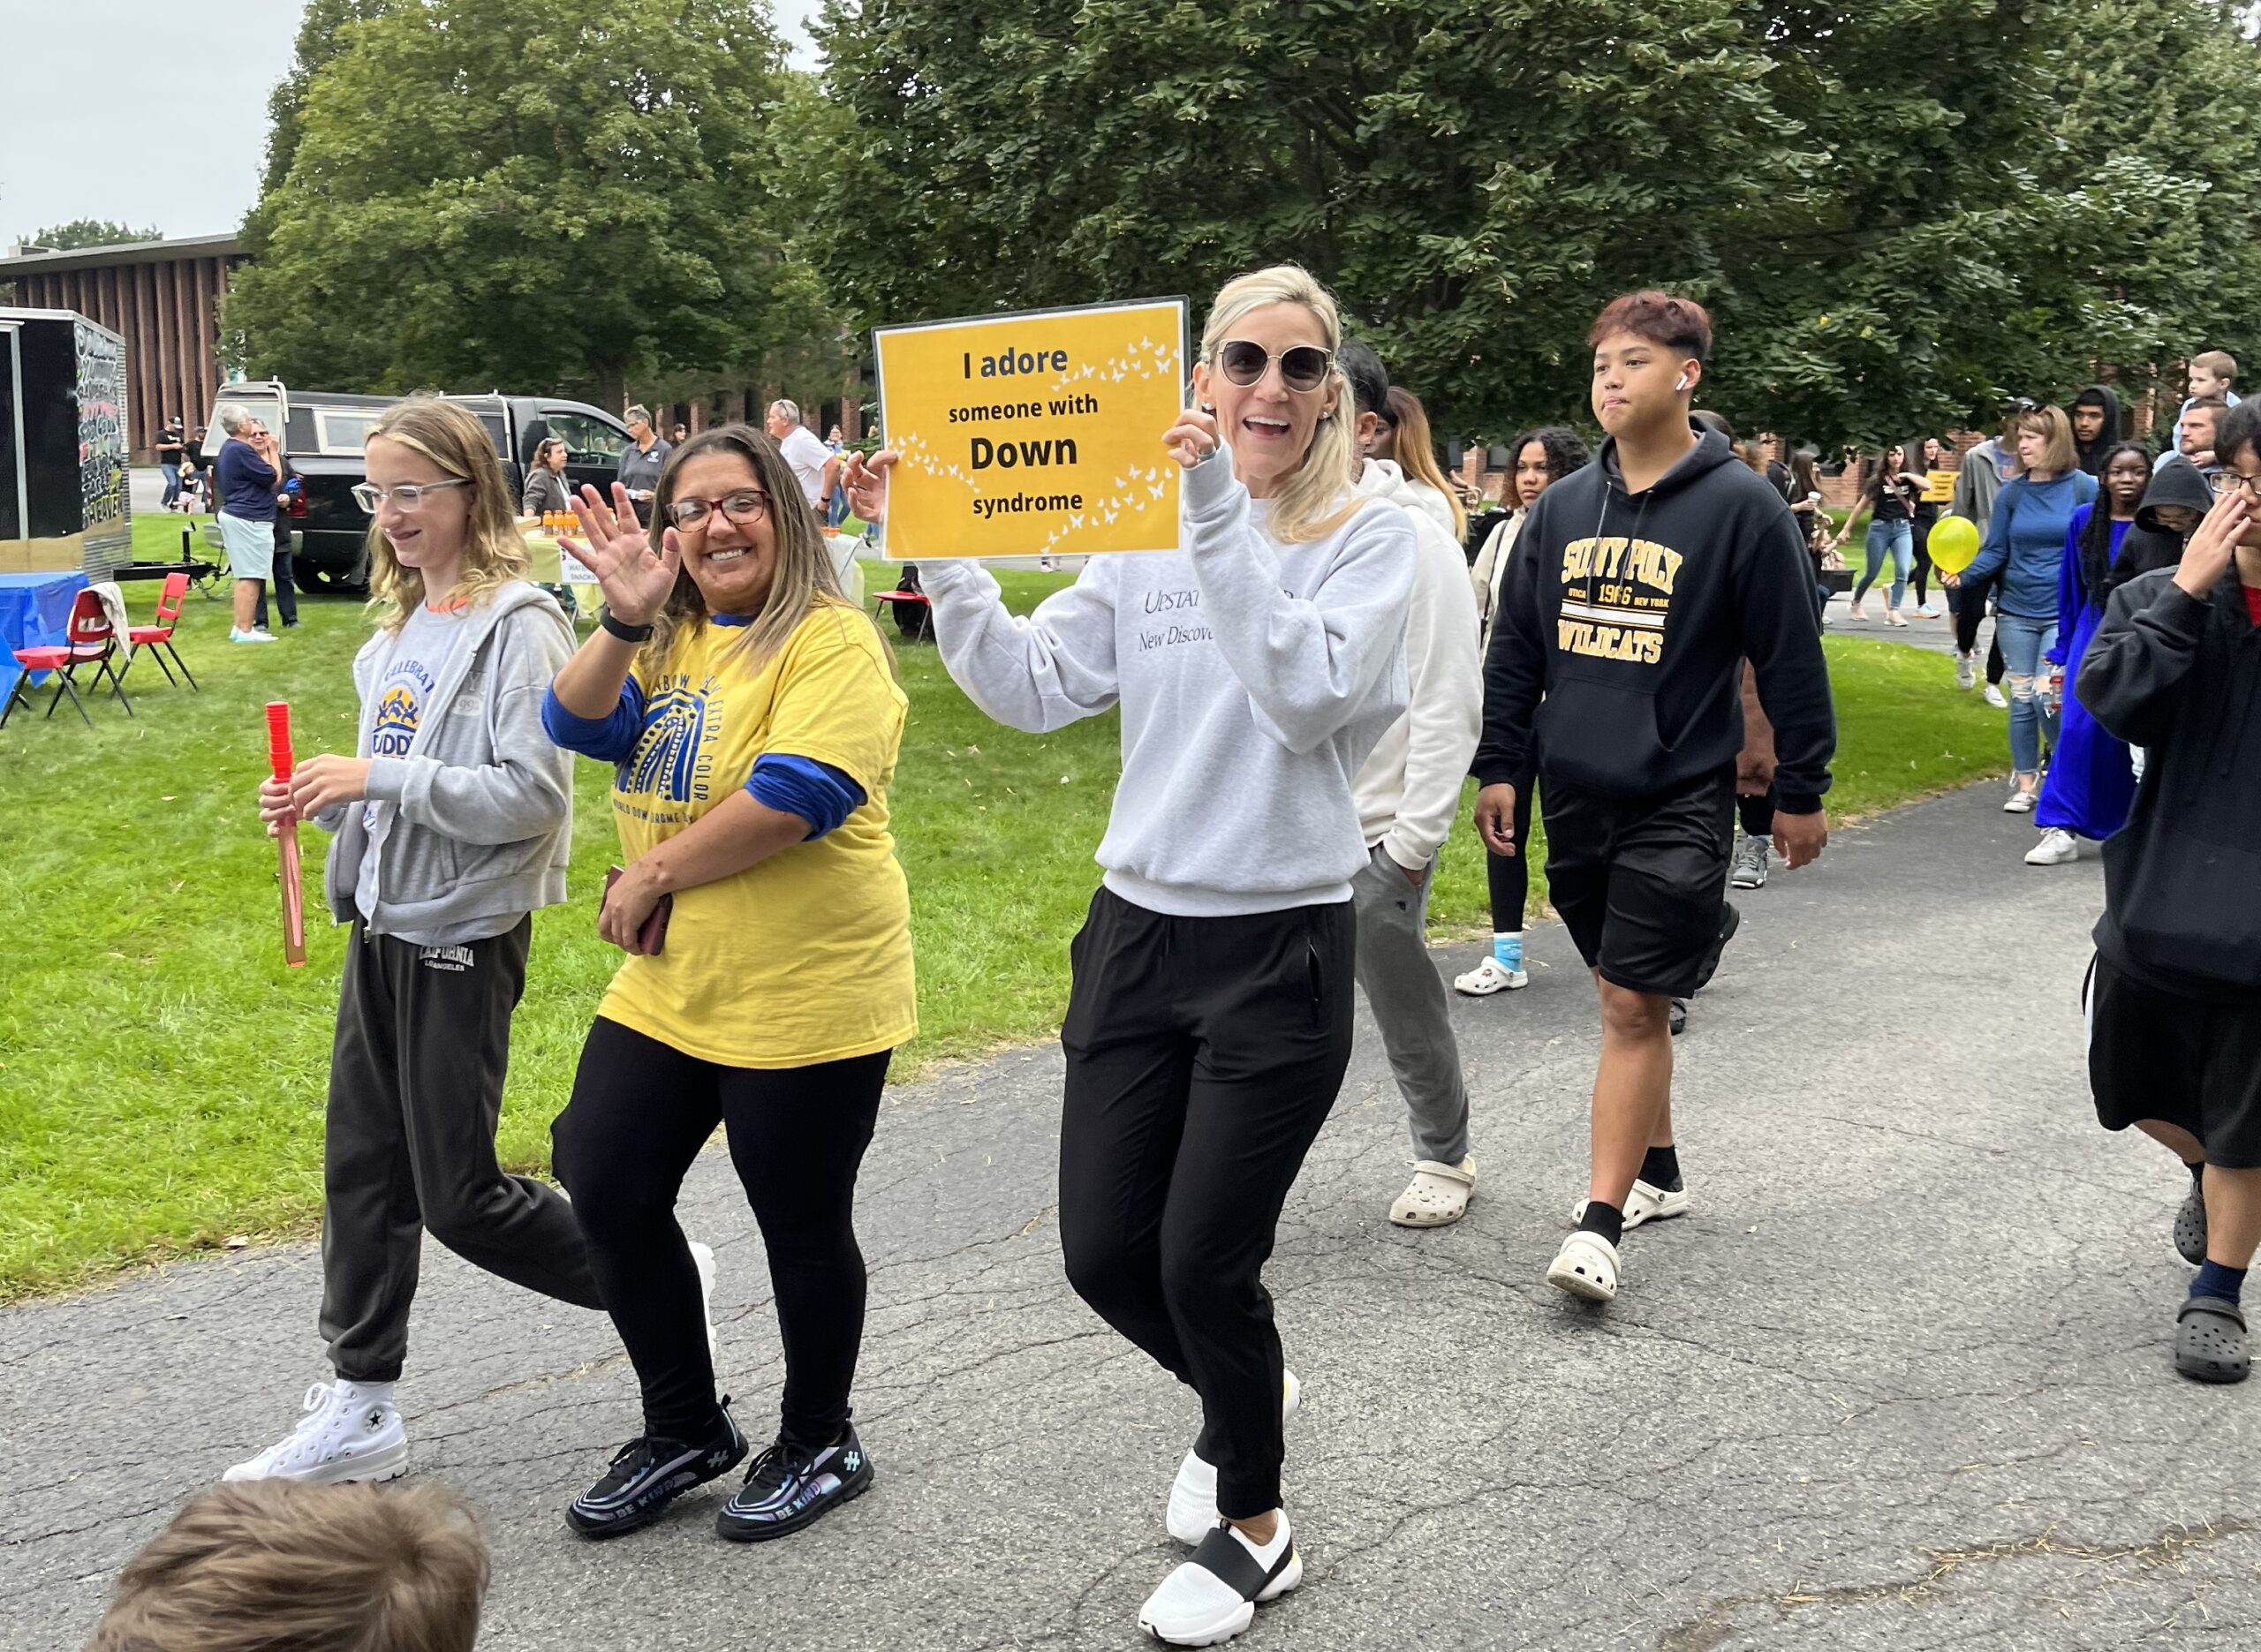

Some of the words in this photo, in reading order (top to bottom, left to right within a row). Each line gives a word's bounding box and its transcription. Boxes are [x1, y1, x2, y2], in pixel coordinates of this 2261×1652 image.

[964, 352, 971, 379] I
[980, 347, 1068, 378] adore
[949, 402, 1042, 423] someone
[1048, 394, 1098, 417] with
[971, 437, 1078, 470] Down
[972, 493, 1083, 519] syndrome
[1561, 537, 1630, 584] SUNY
[1624, 539, 1683, 595] POLY
[1634, 597, 1649, 607] NEW
[1650, 598, 1669, 608] YORK
[1139, 631, 1165, 652] New
[1557, 619, 1664, 664] WILDCATS
[703, 699, 724, 743] EXTRA
[693, 755, 714, 801] COLOR
[616, 1504, 636, 1519] BE
[638, 1479, 674, 1507] KIND
[775, 1505, 795, 1520] BE
[792, 1481, 821, 1511] KIND
